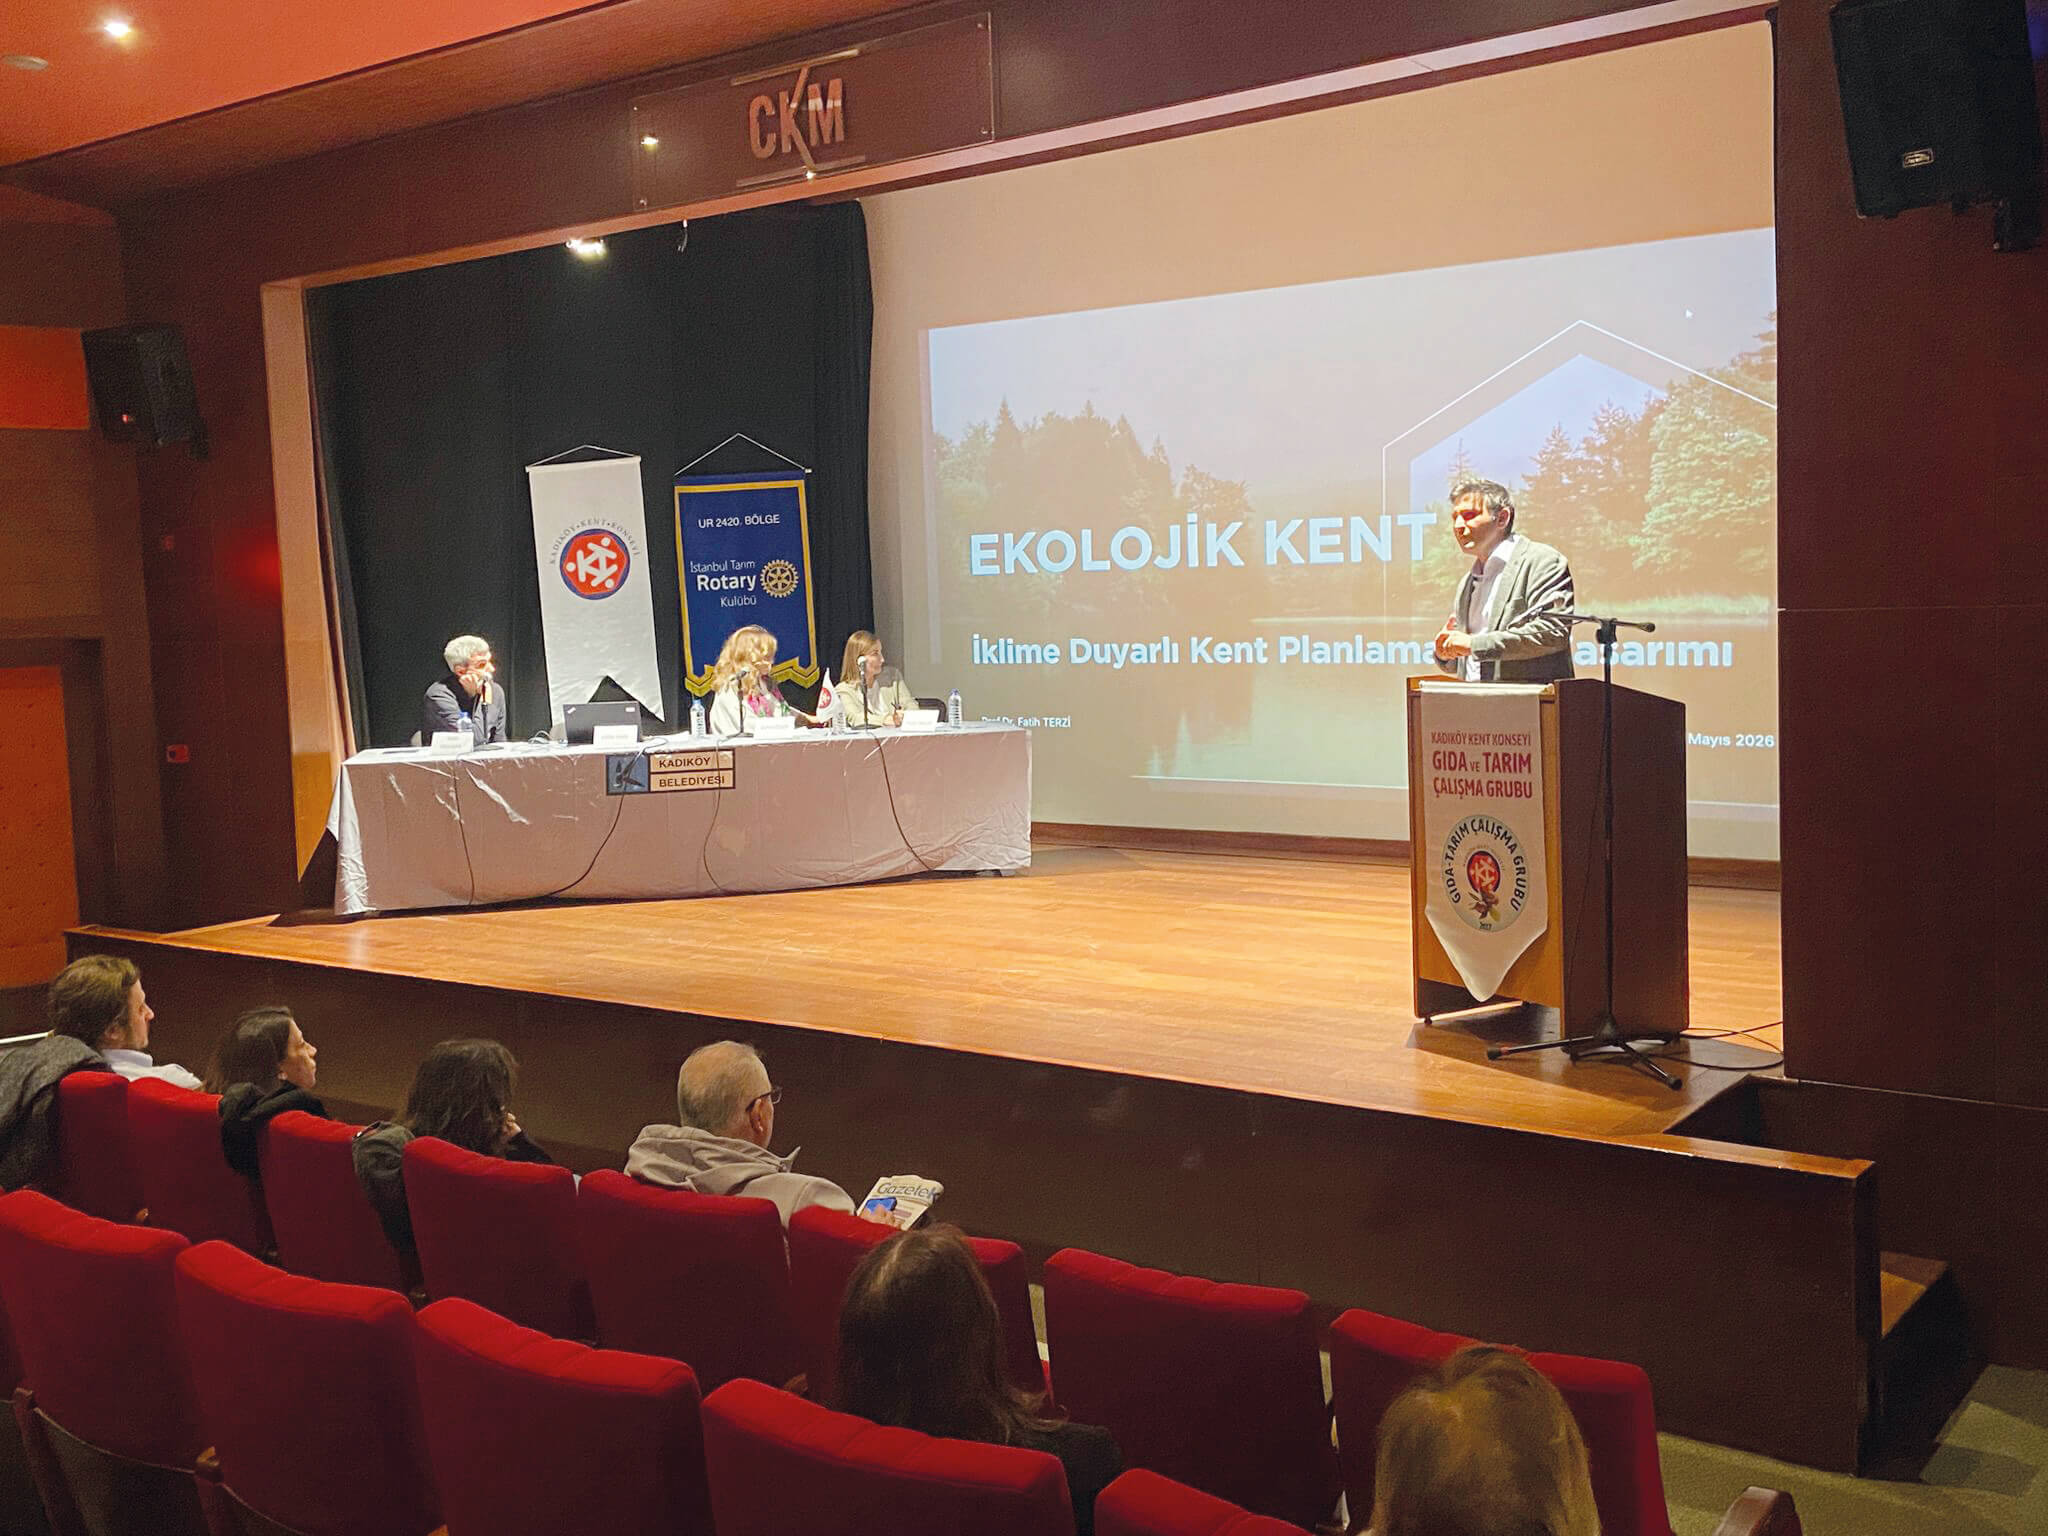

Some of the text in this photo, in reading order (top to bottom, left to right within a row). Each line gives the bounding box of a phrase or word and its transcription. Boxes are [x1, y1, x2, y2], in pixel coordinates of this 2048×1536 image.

[750, 66, 844, 169] CKM
[698, 519, 714, 529] UR
[744, 514, 780, 525] BÖLGE
[970, 512, 1437, 576] EKOLOJİK KENT
[696, 574, 756, 592] Rotary
[720, 595, 757, 608] Kulübü
[972, 634, 1733, 669] İklime Duyarlı Kent Planlama asarımı
[1017, 716, 1041, 728] Fatih
[1042, 715, 1072, 728] TERZİ
[1431, 730, 1531, 746] KADIKÖY KENT KONSEYİ
[1688, 733, 1775, 749] Mayıs 2026
[1432, 750, 1532, 774] GIDA VE TARIM
[1433, 777, 1533, 799] ÇALIŞMA GRUBU
[1470, 818, 1518, 855] ÇALIŞMA
[1510, 855, 1527, 912] GRUBU
